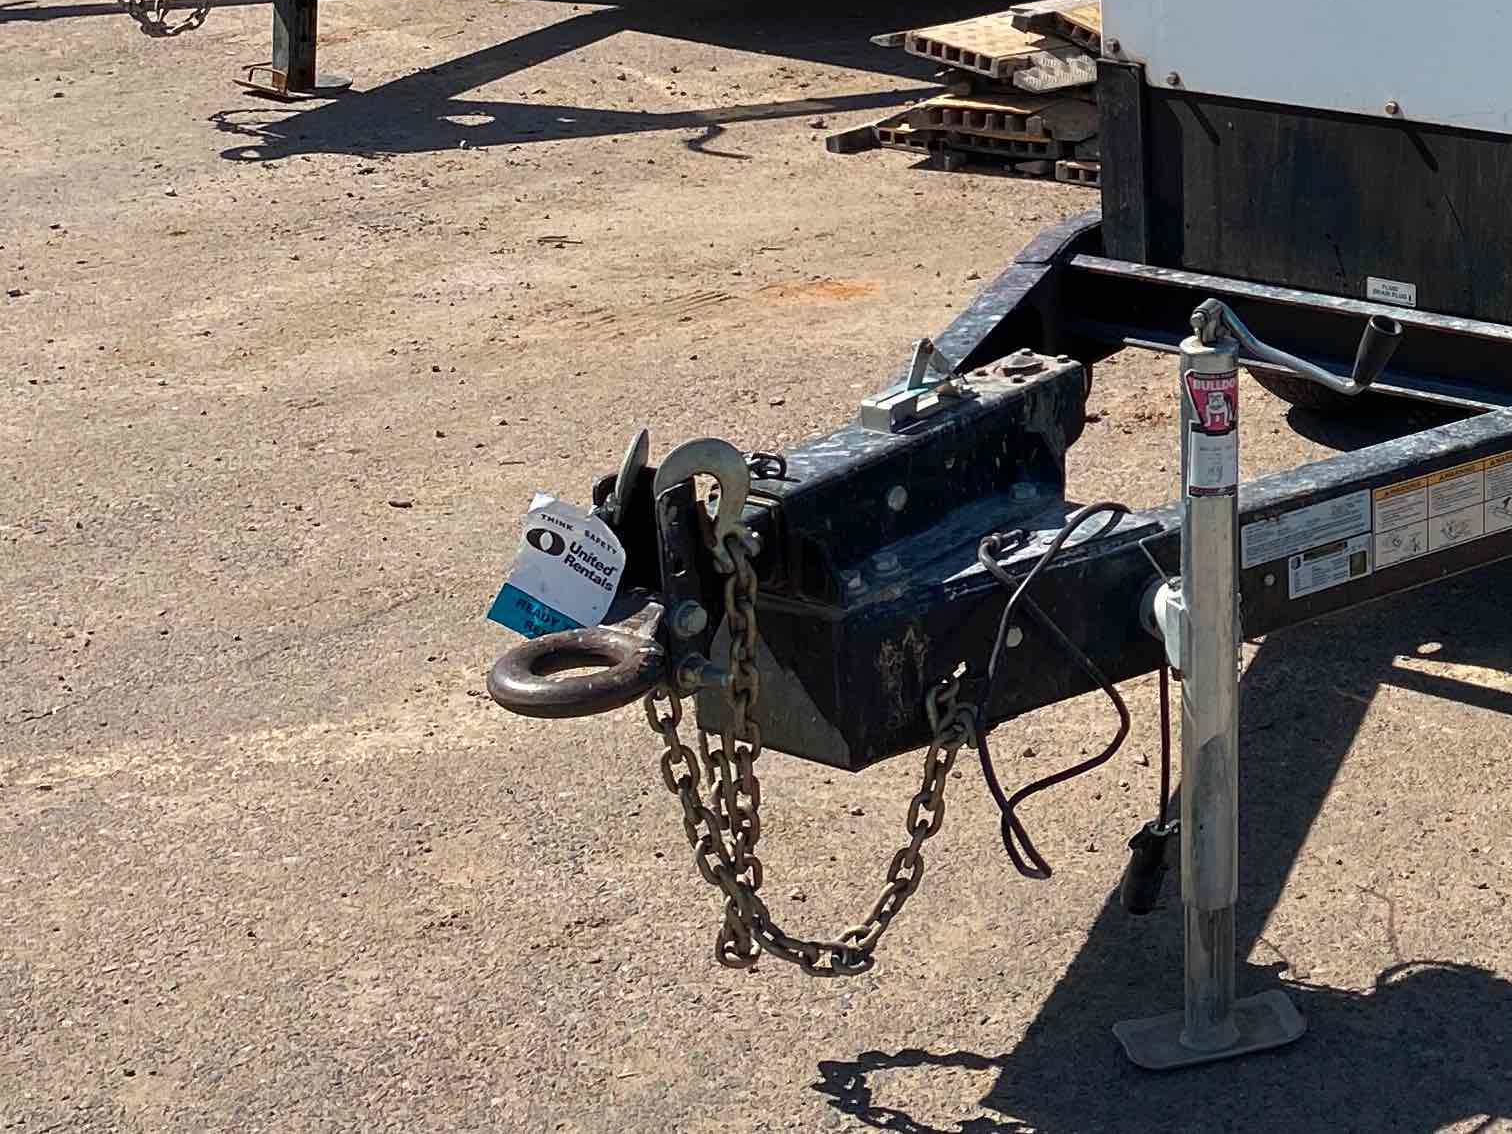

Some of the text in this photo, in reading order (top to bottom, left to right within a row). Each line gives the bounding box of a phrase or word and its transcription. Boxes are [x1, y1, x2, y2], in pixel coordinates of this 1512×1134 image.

[540, 514, 618, 555] THINK SAFETY
[563, 554, 614, 592] Rentals
[569, 541, 616, 577] United
